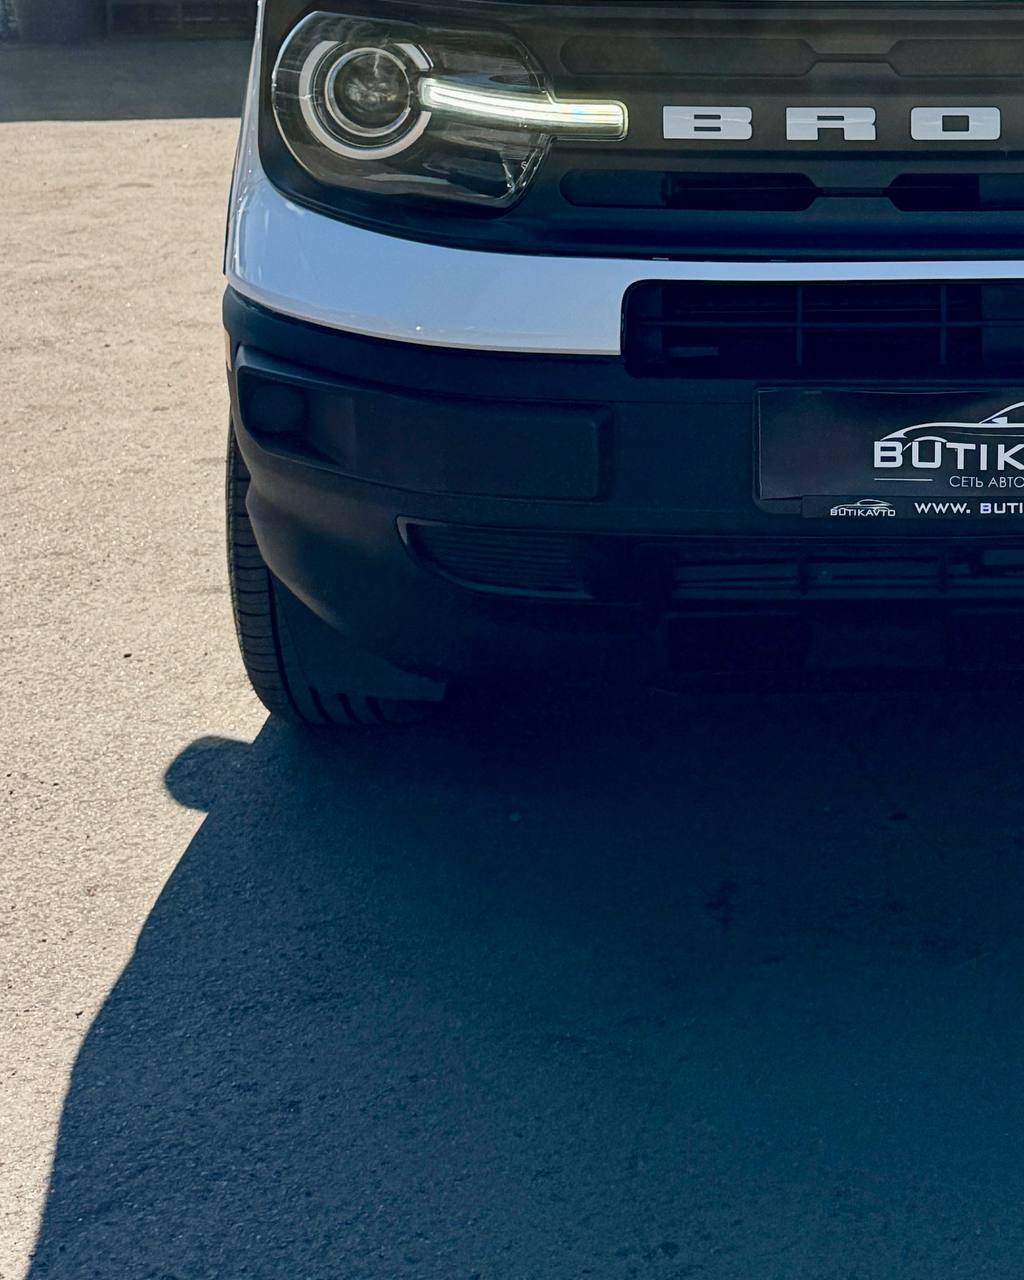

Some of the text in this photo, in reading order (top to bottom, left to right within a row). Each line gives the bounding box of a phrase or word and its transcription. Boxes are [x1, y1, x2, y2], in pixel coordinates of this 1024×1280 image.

[949, 475, 984, 488] СЕТЬ
[830, 508, 896, 517] BUTIKAVTO
[914, 502, 971, 514] WWW.
